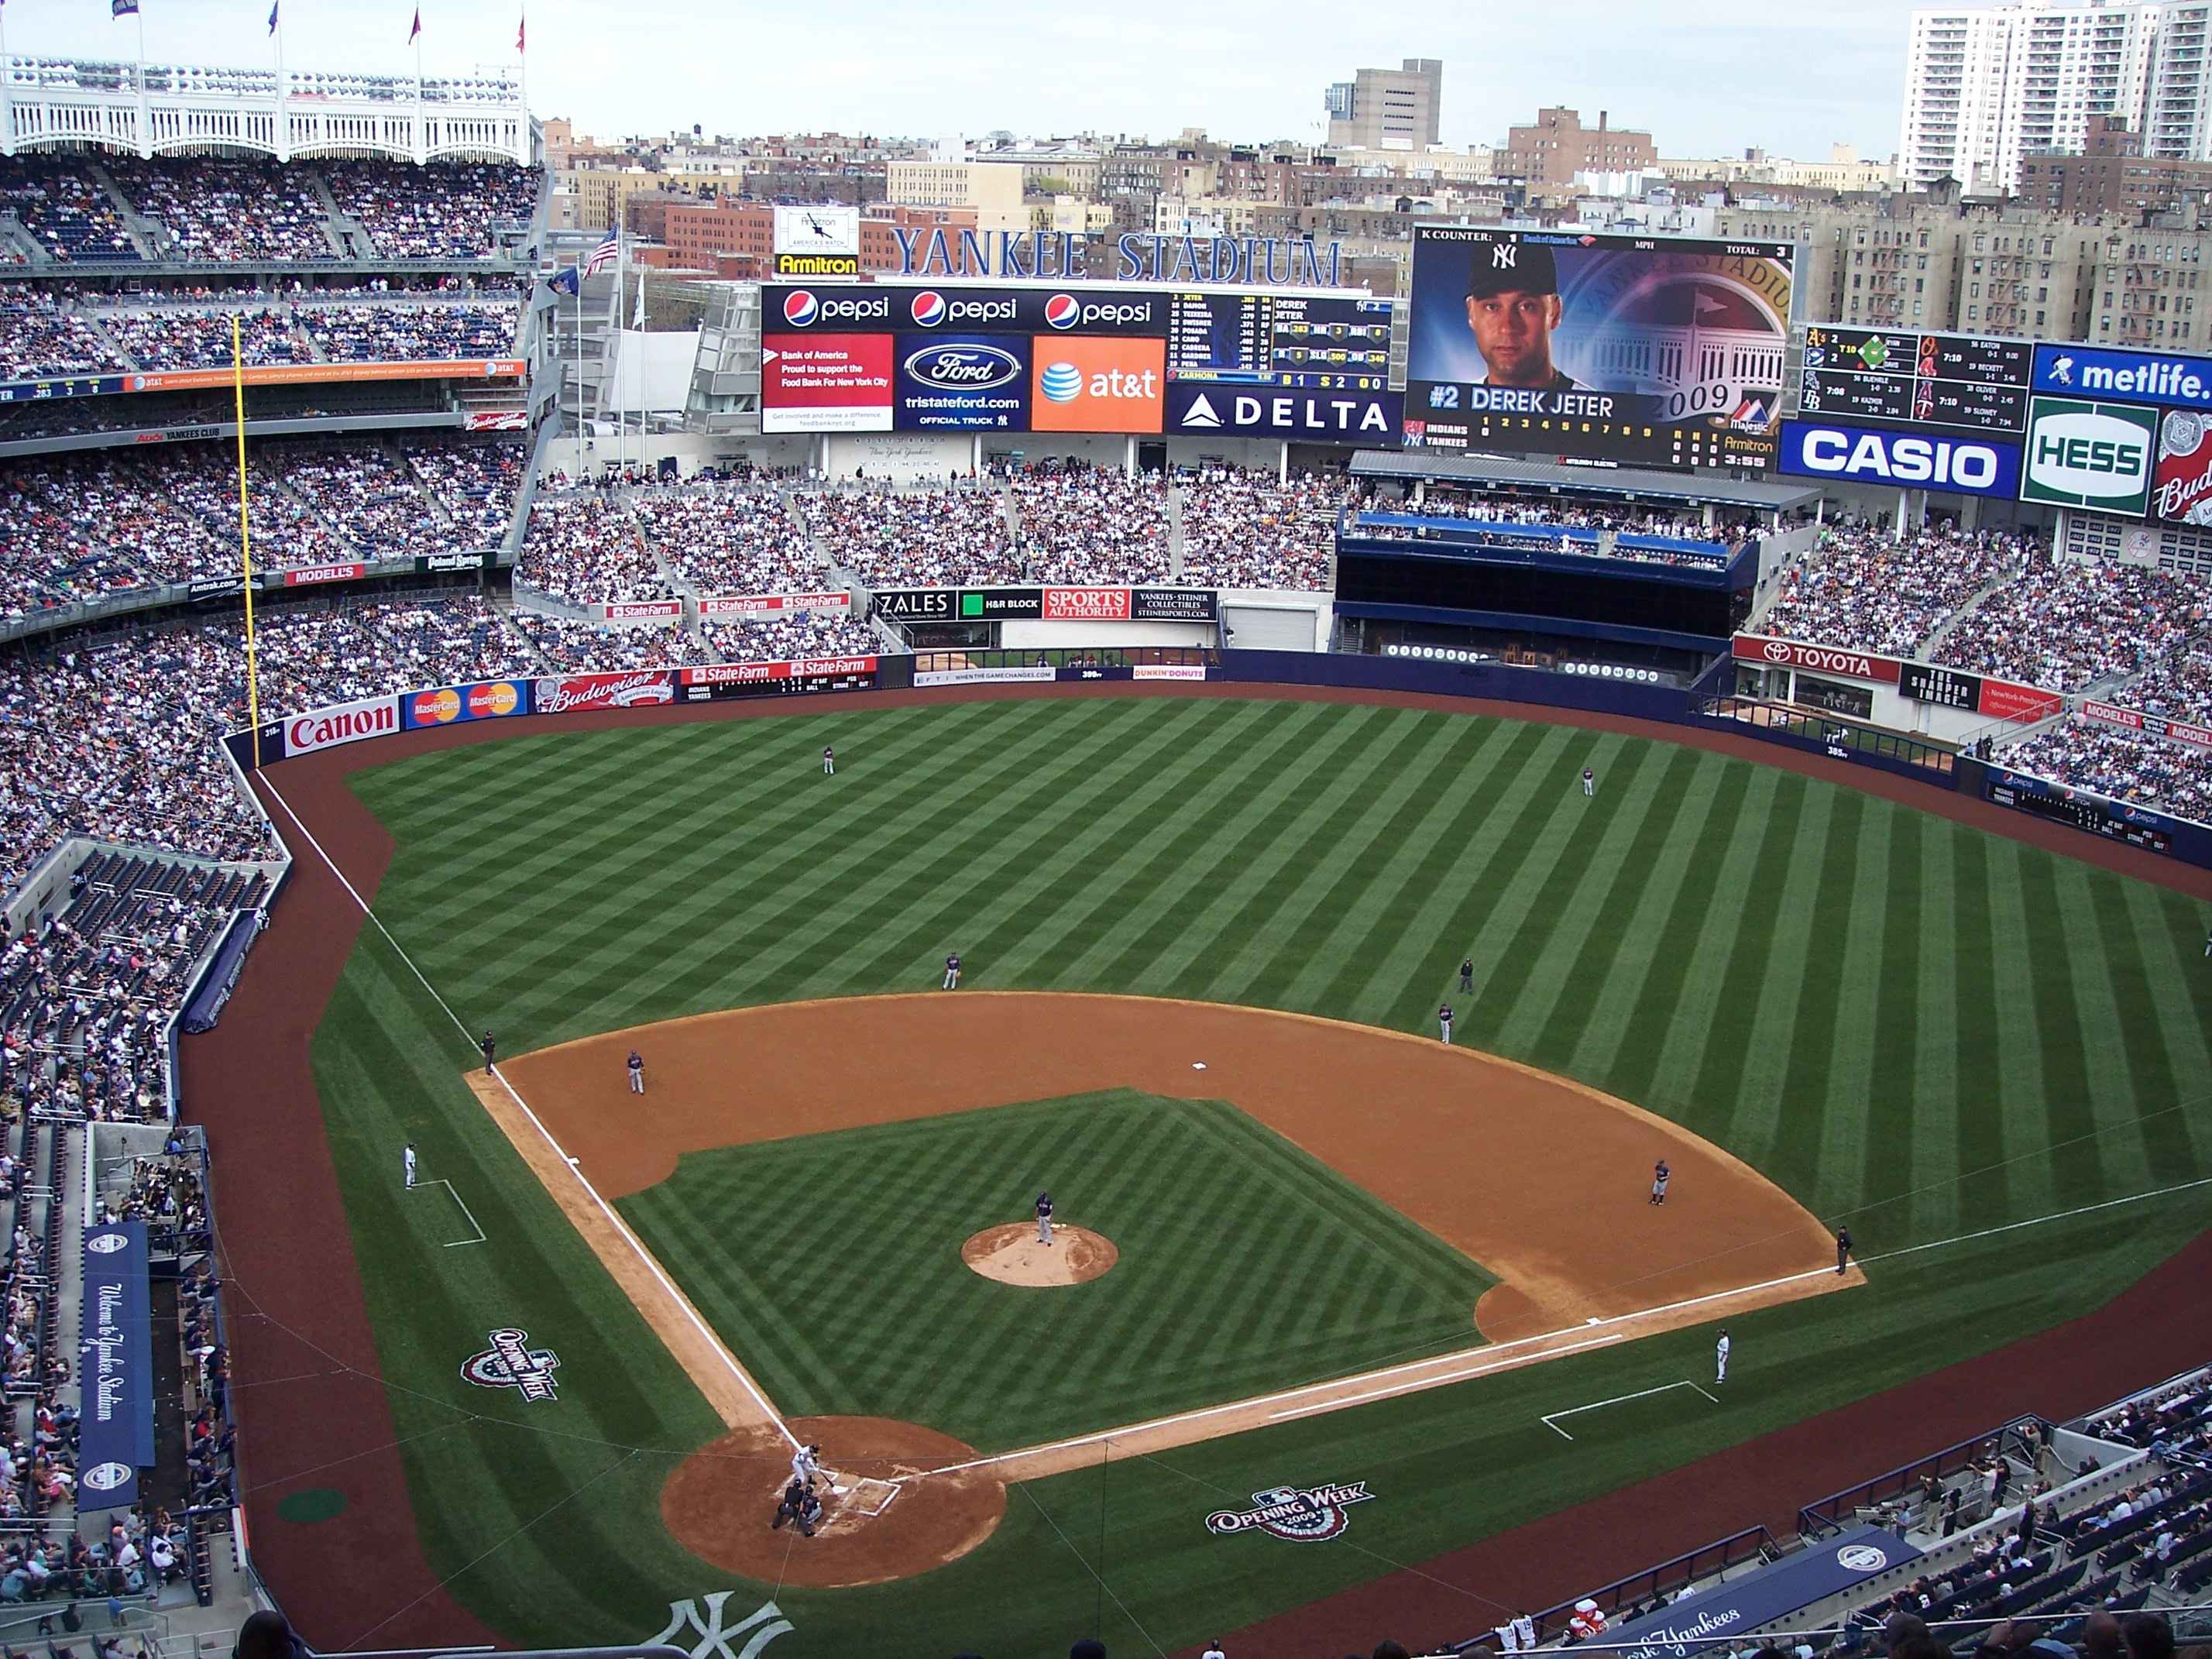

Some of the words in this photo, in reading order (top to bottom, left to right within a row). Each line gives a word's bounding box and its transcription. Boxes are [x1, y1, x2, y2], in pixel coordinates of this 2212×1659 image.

[1422, 230, 1431, 239] K
[1433, 230, 1492, 242] COUNTER:
[1509, 234, 1517, 242] 1
[1635, 241, 1654, 249] MPH
[1726, 246, 1760, 255] TOTAL:
[1777, 246, 1785, 257] 3
[780, 256, 856, 273] Armitron
[890, 228, 1087, 280] YANKEE
[1118, 233, 1344, 288] STADIUM
[822, 297, 888, 321] pepsi
[949, 298, 1017, 321] pepsi
[1276, 301, 1307, 310] DEREK
[1083, 302, 1151, 325] pepsi
[1275, 311, 1304, 320] JETER
[1351, 328, 1366, 336] RBI
[1832, 335, 1838, 343] 2
[781, 351, 802, 359] Bank
[804, 351, 813, 359] of
[814, 351, 847, 359] America
[1310, 351, 1327, 359] SLG
[1831, 353, 1838, 362] 2
[1943, 353, 1962, 362] 7:10
[781, 365, 805, 373] Proud
[817, 366, 848, 375] support
[931, 353, 994, 380] Ford
[146, 377, 162, 386] at&t
[781, 378, 800, 386] Food
[802, 378, 821, 386] Bank
[824, 378, 836, 386] For
[837, 378, 854, 386] New
[854, 378, 872, 386] York
[874, 379, 888, 388] City
[1090, 369, 1156, 398] at&t
[1283, 375, 1291, 384] B
[1297, 375, 1304, 386] 1
[1321, 376, 1330, 386] S
[1337, 377, 1345, 387] 2
[67, 387, 73, 396] 3
[1826, 387, 1845, 396] 7:08
[1976, 386, 1997, 394] OLIVER
[905, 397, 1019, 409] tristateford.com
[1430, 386, 1458, 409] #2
[1472, 387, 1545, 413] DEREK
[1551, 394, 1613, 417] JETER
[1939, 397, 1957, 406] 7:10
[919, 416, 960, 424] OFFICIAL
[1235, 397, 1388, 431] DELTA
[1427, 424, 1468, 434] INDIANS
[1483, 417, 1489, 425] 1
[1522, 419, 1529, 428] 3
[1541, 421, 1549, 429] 4
[1562, 422, 1569, 431] 5
[1603, 425, 1610, 434] 7
[1644, 428, 1651, 437] 9
[1730, 420, 1767, 432] Majestic
[167, 429, 199, 440] YANKEES
[201, 428, 220, 437] CLUB
[1426, 437, 1468, 448] YANKEES
[1725, 436, 1772, 452] Armitron
[1725, 455, 1765, 467] 3:55
[1802, 430, 1997, 488] CASIO
[2038, 435, 2142, 476] HESS
[428, 555, 455, 569] Poland
[456, 554, 483, 568] Spring
[296, 567, 353, 583] MODELL'S
[191, 579, 237, 593] Amtrak.com
[881, 594, 947, 613] ZALES
[986, 600, 1005, 609] H&R
[1008, 599, 1038, 608] BLOCK
[1049, 591, 1125, 607] SPORTS
[1049, 607, 1124, 617] AUTHORITY
[1794, 647, 1871, 676] TOYOTA
[1931, 670, 1952, 683] THE
[548, 672, 654, 713] Budweiser
[1911, 676, 1968, 697] SHARPER
[469, 693, 517, 707] MasterCard
[414, 702, 460, 715] MasterCard
[2087, 705, 2137, 726] MODELL'S
[290, 706, 393, 748] Canon
[2136, 814, 2157, 824] pepsi
[2102, 826, 2113, 834] BALL
[99, 1283, 122, 1325] Welcome
[99, 1326, 119, 1336] to
[85, 1334, 125, 1373] Yankee
[495, 1331, 532, 1371] OPENING
[518, 1369, 551, 1397] WEEK
[98, 1375, 125, 1421] Stadium
[1217, 1502, 1306, 1530] OPENING
[1298, 1486, 1362, 1508] WEEK
[1284, 1511, 1316, 1526] 2009
[1650, 1609, 1740, 1657] Yankees
